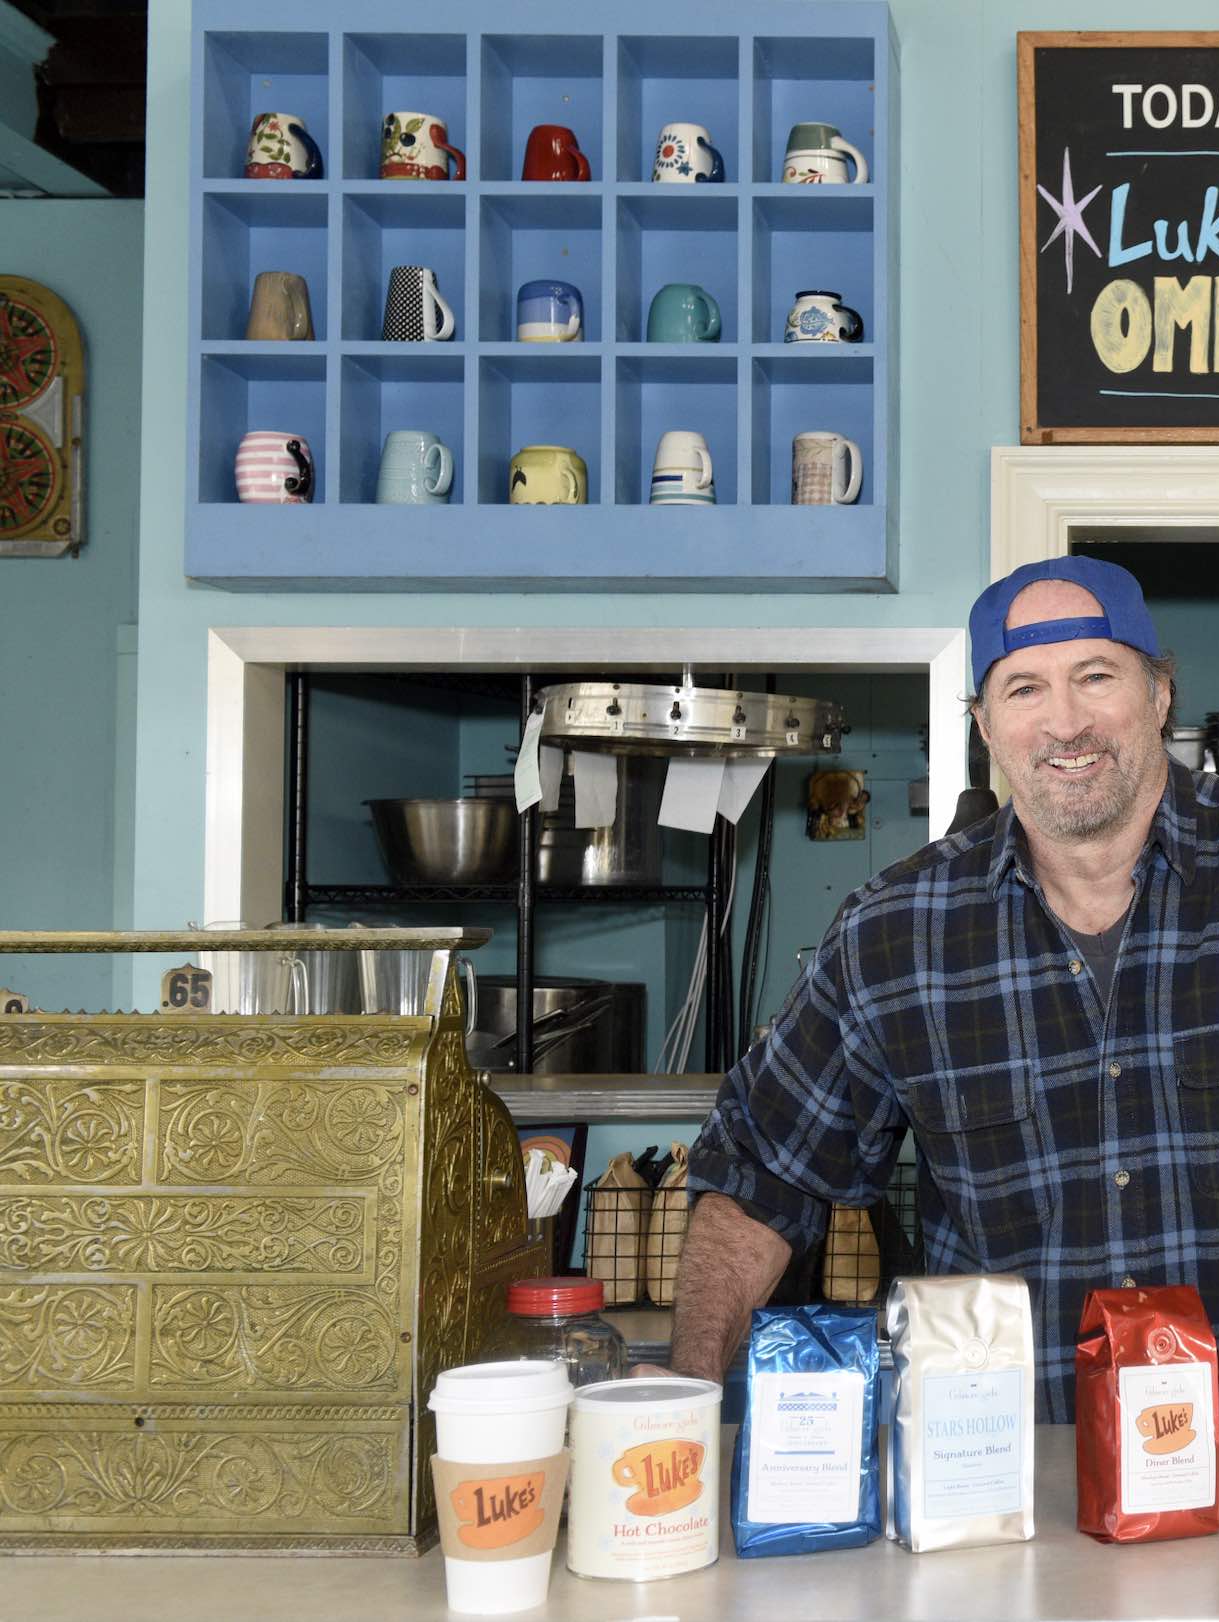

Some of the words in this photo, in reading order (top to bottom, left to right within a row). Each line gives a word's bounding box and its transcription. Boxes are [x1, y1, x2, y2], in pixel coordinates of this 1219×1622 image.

[933, 1448, 983, 1461] Signature
[985, 1442, 1011, 1456] Blend
[1171, 1455, 1195, 1465] Blend
[613, 1523, 641, 1537] Hot
[645, 1517, 709, 1536] Chocolate
